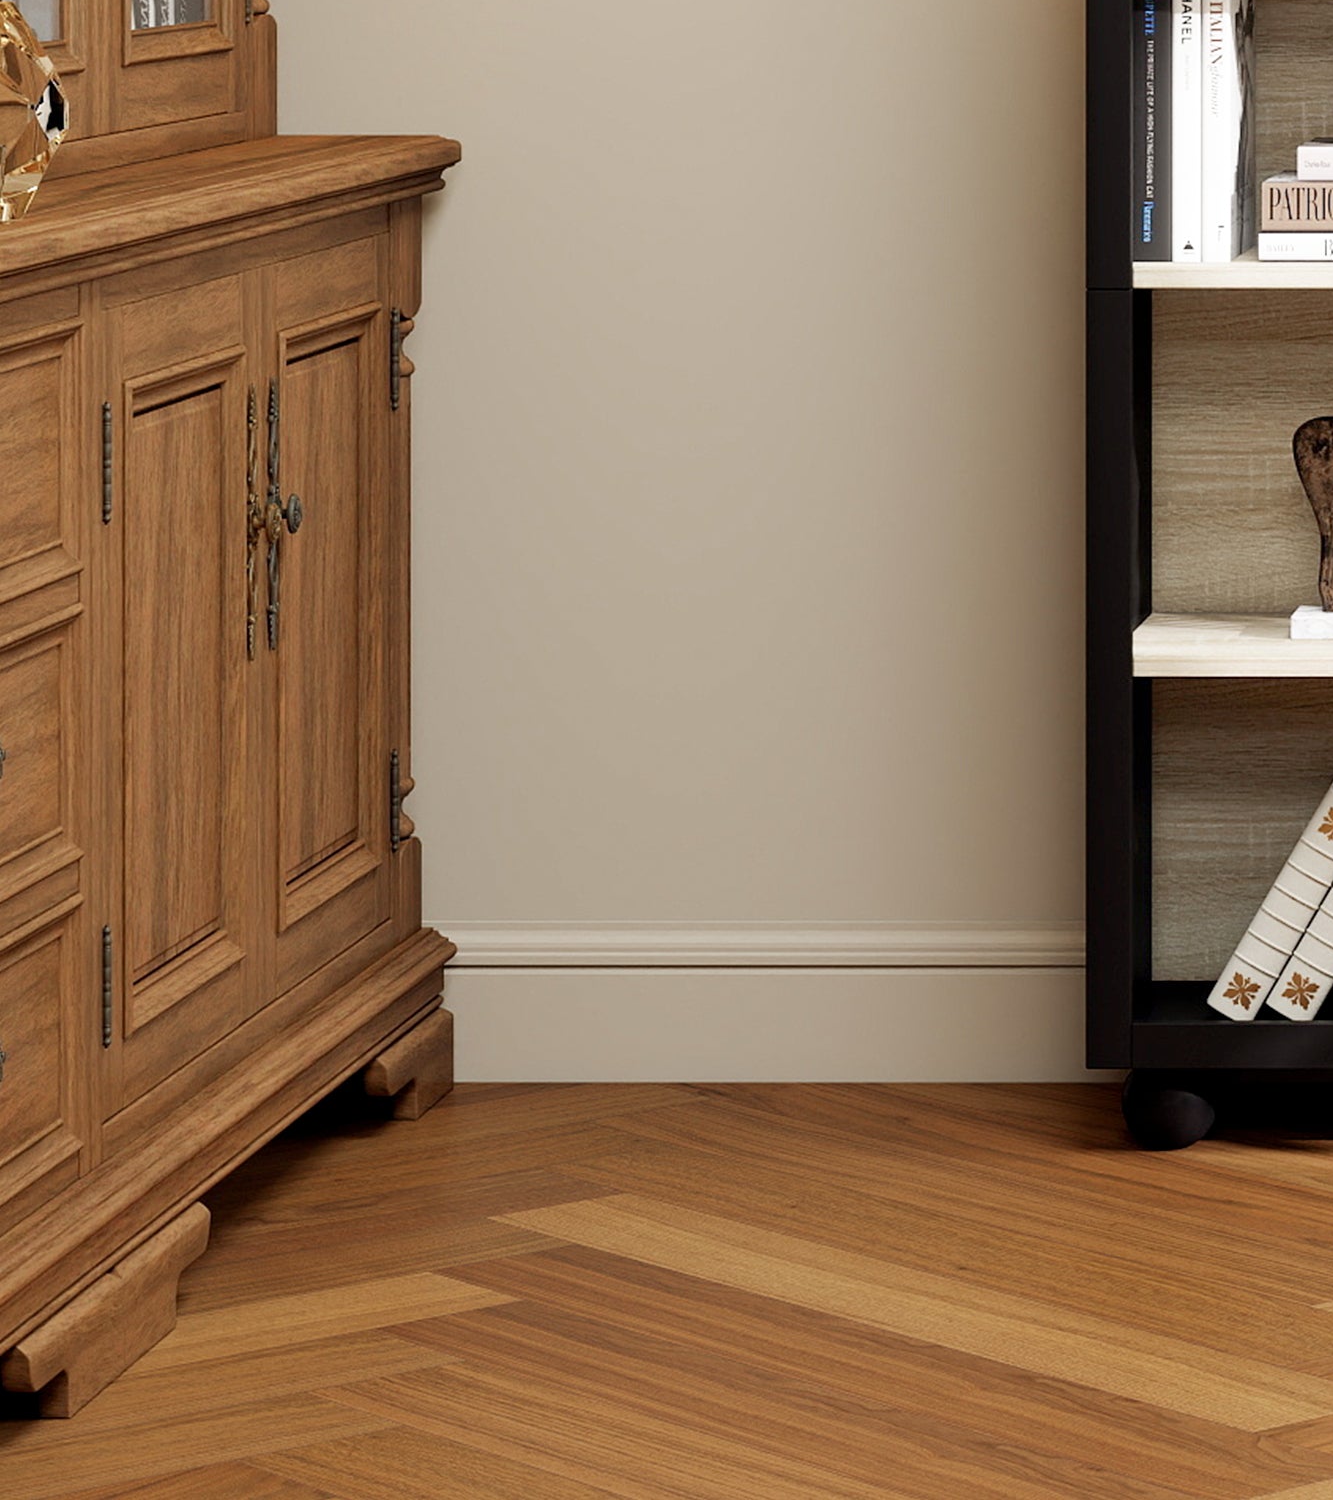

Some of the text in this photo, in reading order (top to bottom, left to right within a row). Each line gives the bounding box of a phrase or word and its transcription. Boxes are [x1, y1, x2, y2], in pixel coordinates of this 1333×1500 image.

[1210, 2, 1223, 64] ITALIAN
[1146, 40, 1154, 52] THE
[1146, 53, 1154, 80] PRIVATE
[1146, 82, 1154, 95] LIFE
[1146, 97, 1154, 106] OF
[1146, 156, 1154, 184] FASHION
[1146, 186, 1154, 198] CAT
